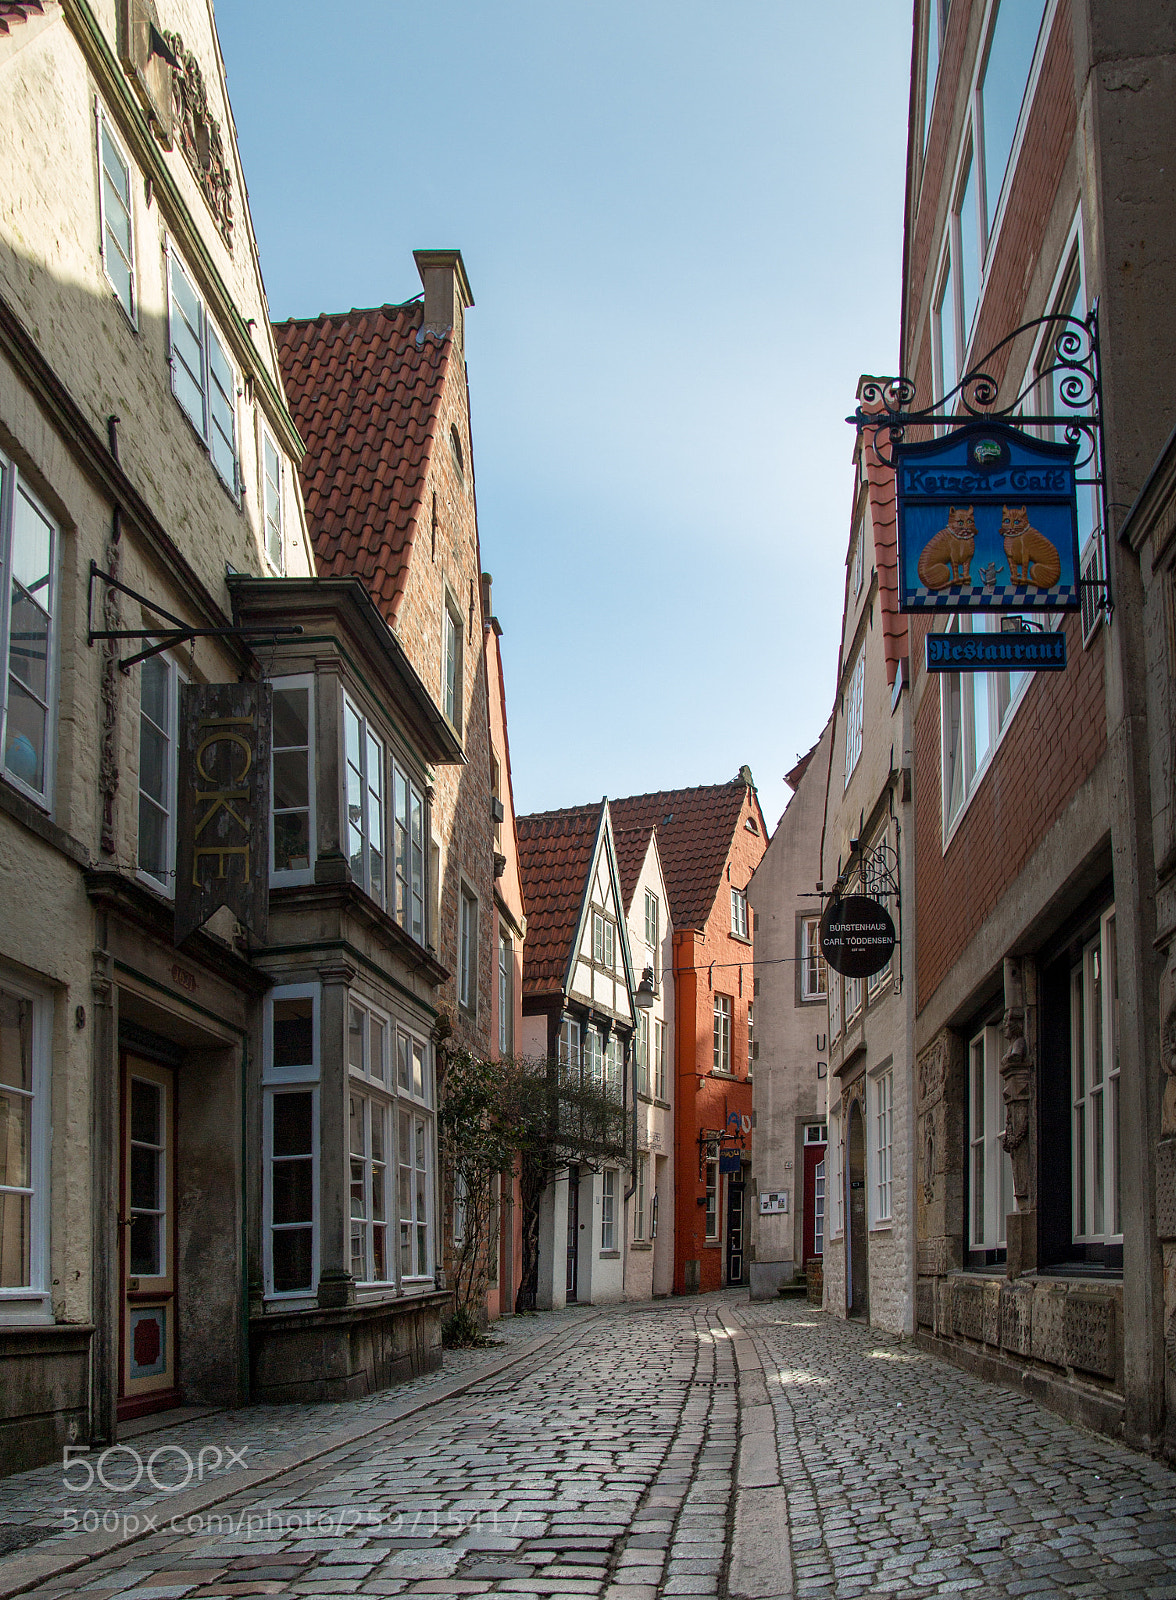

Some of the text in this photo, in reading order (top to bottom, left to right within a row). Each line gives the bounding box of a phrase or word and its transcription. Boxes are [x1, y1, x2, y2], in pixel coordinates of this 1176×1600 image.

[929, 639, 1065, 662] Restaurant
[193, 714, 254, 888] ICKE
[829, 922, 886, 932] BÜRSTENHAUS
[823, 936, 893, 946] CARL TÖDDENSEN
[76, 1005, 86, 1029] 9
